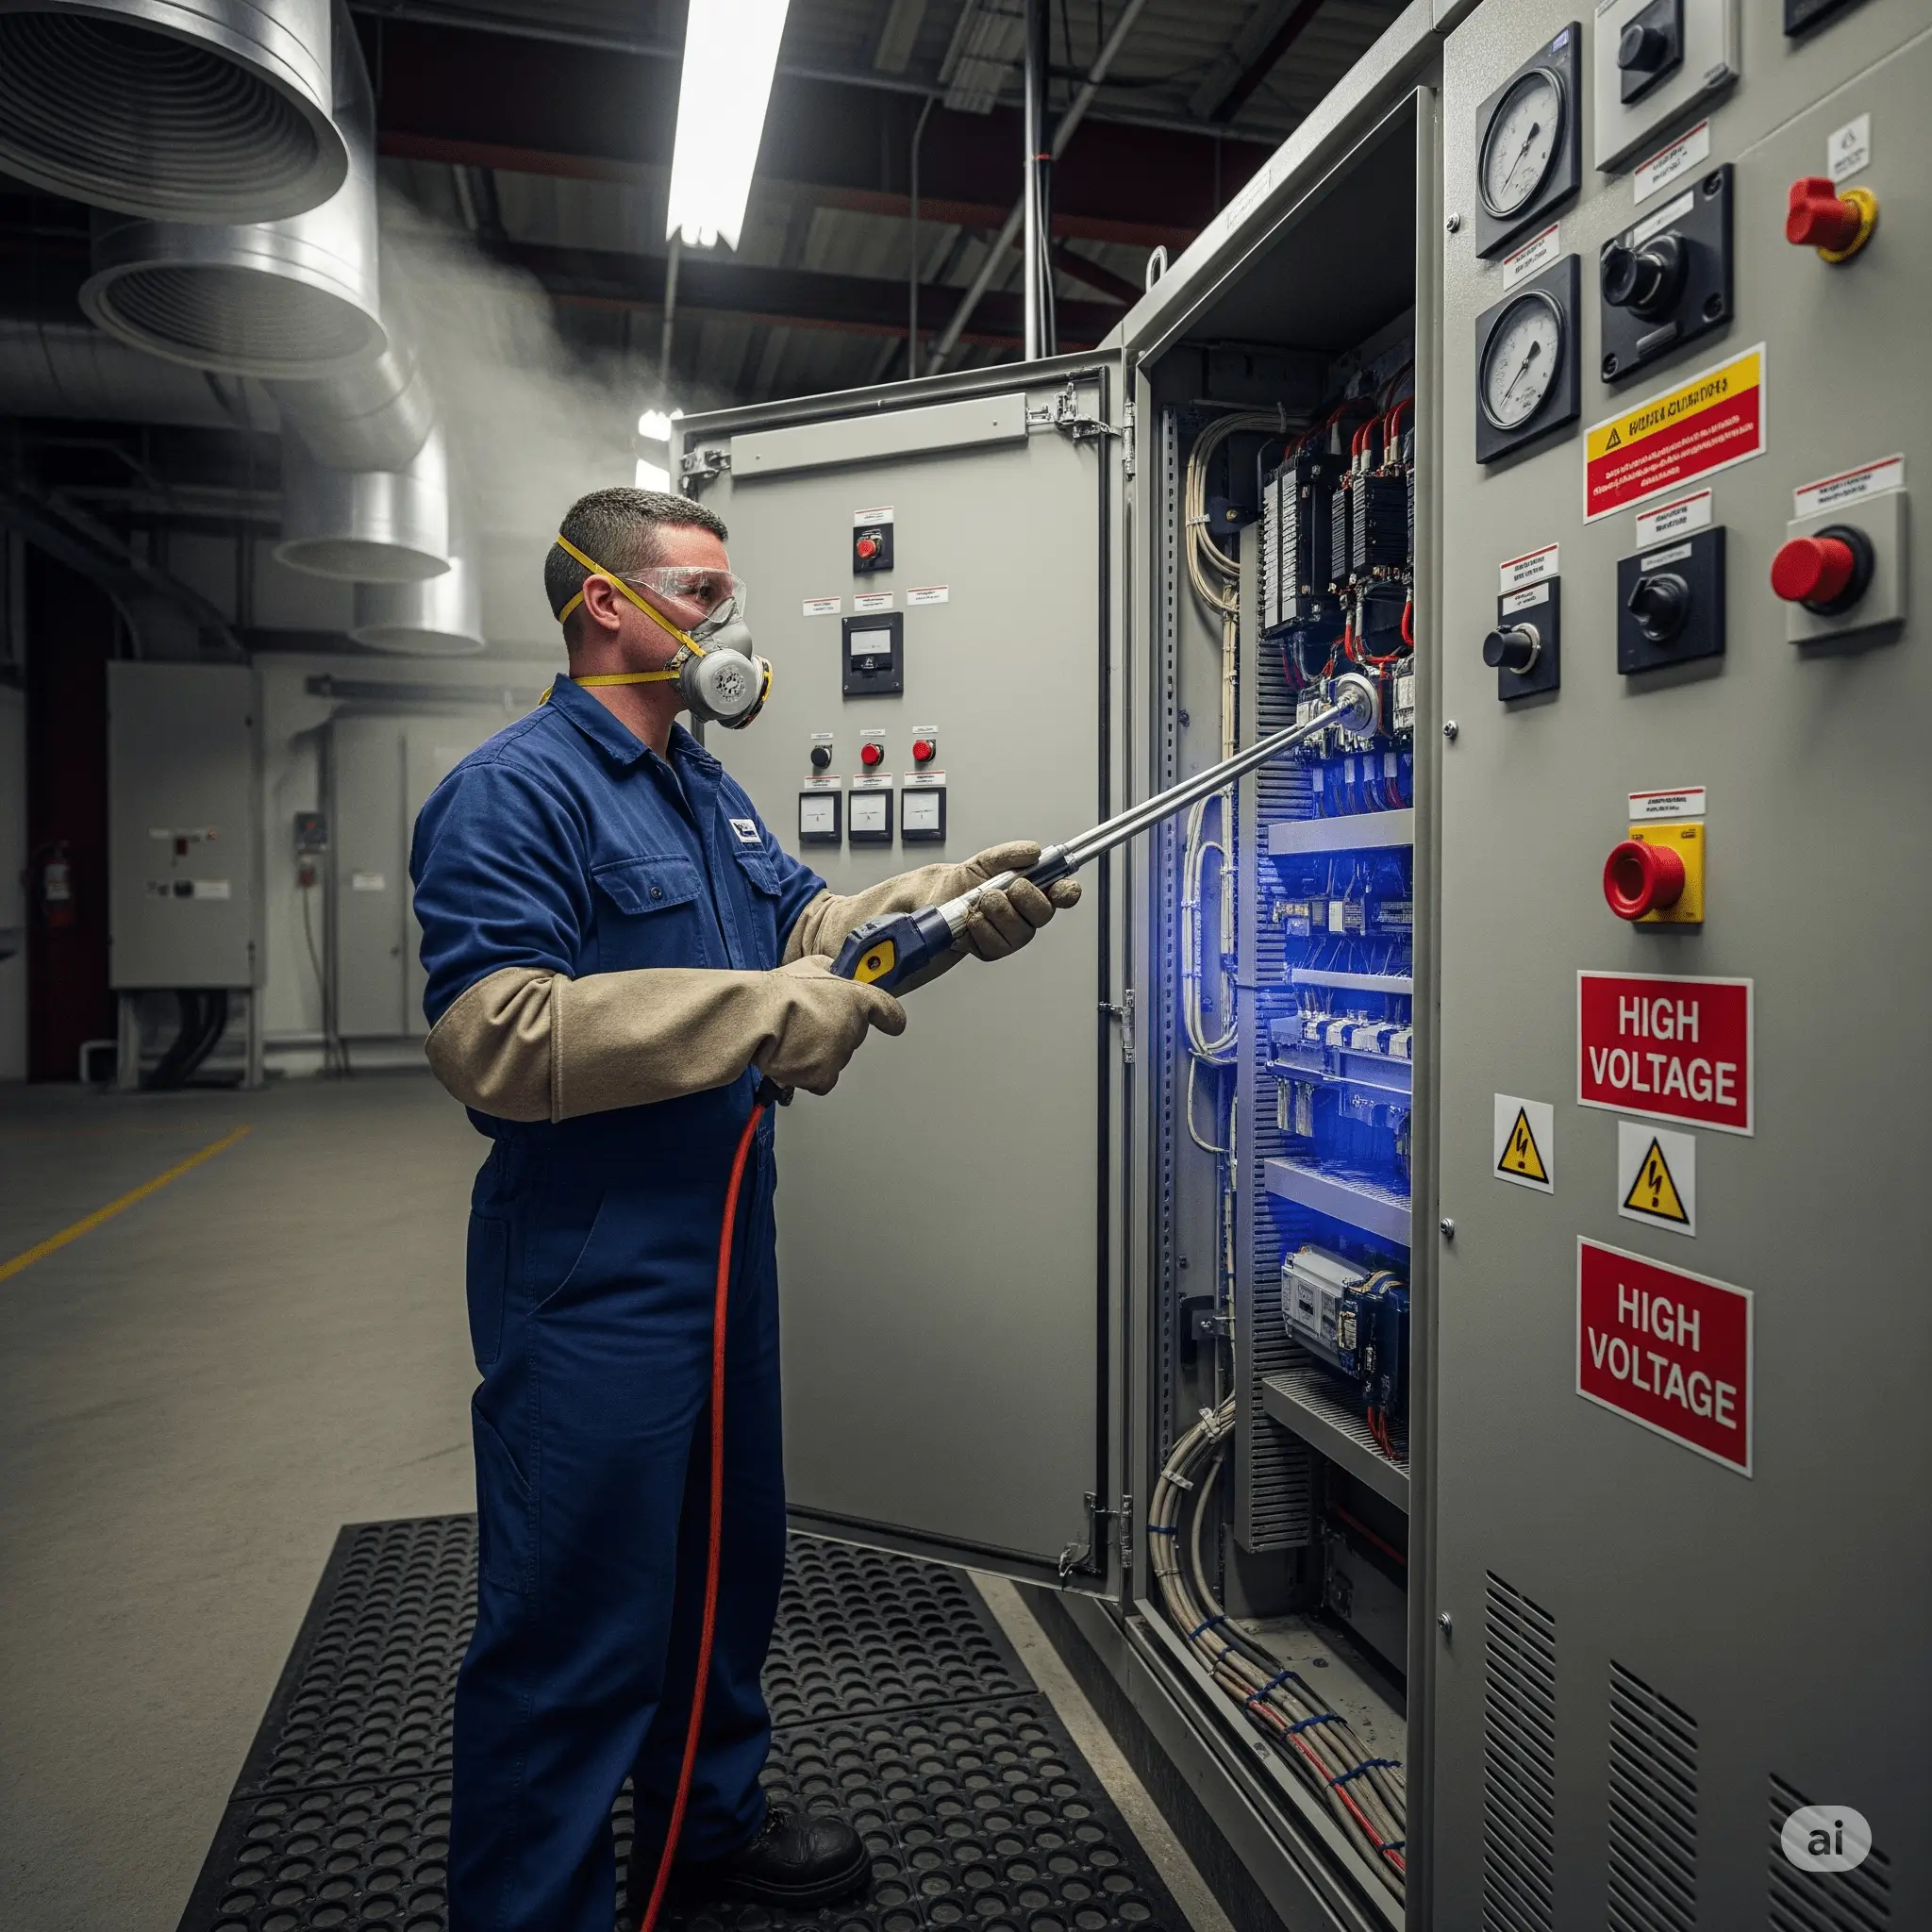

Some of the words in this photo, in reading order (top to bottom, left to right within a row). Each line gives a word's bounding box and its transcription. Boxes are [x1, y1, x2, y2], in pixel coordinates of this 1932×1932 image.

[1619, 995, 1699, 1043] HIGH
[1589, 1046, 1738, 1107] VOLTAGE
[1618, 1283, 1700, 1353] HIGH
[1588, 1326, 1737, 1429] VOLTAGE
